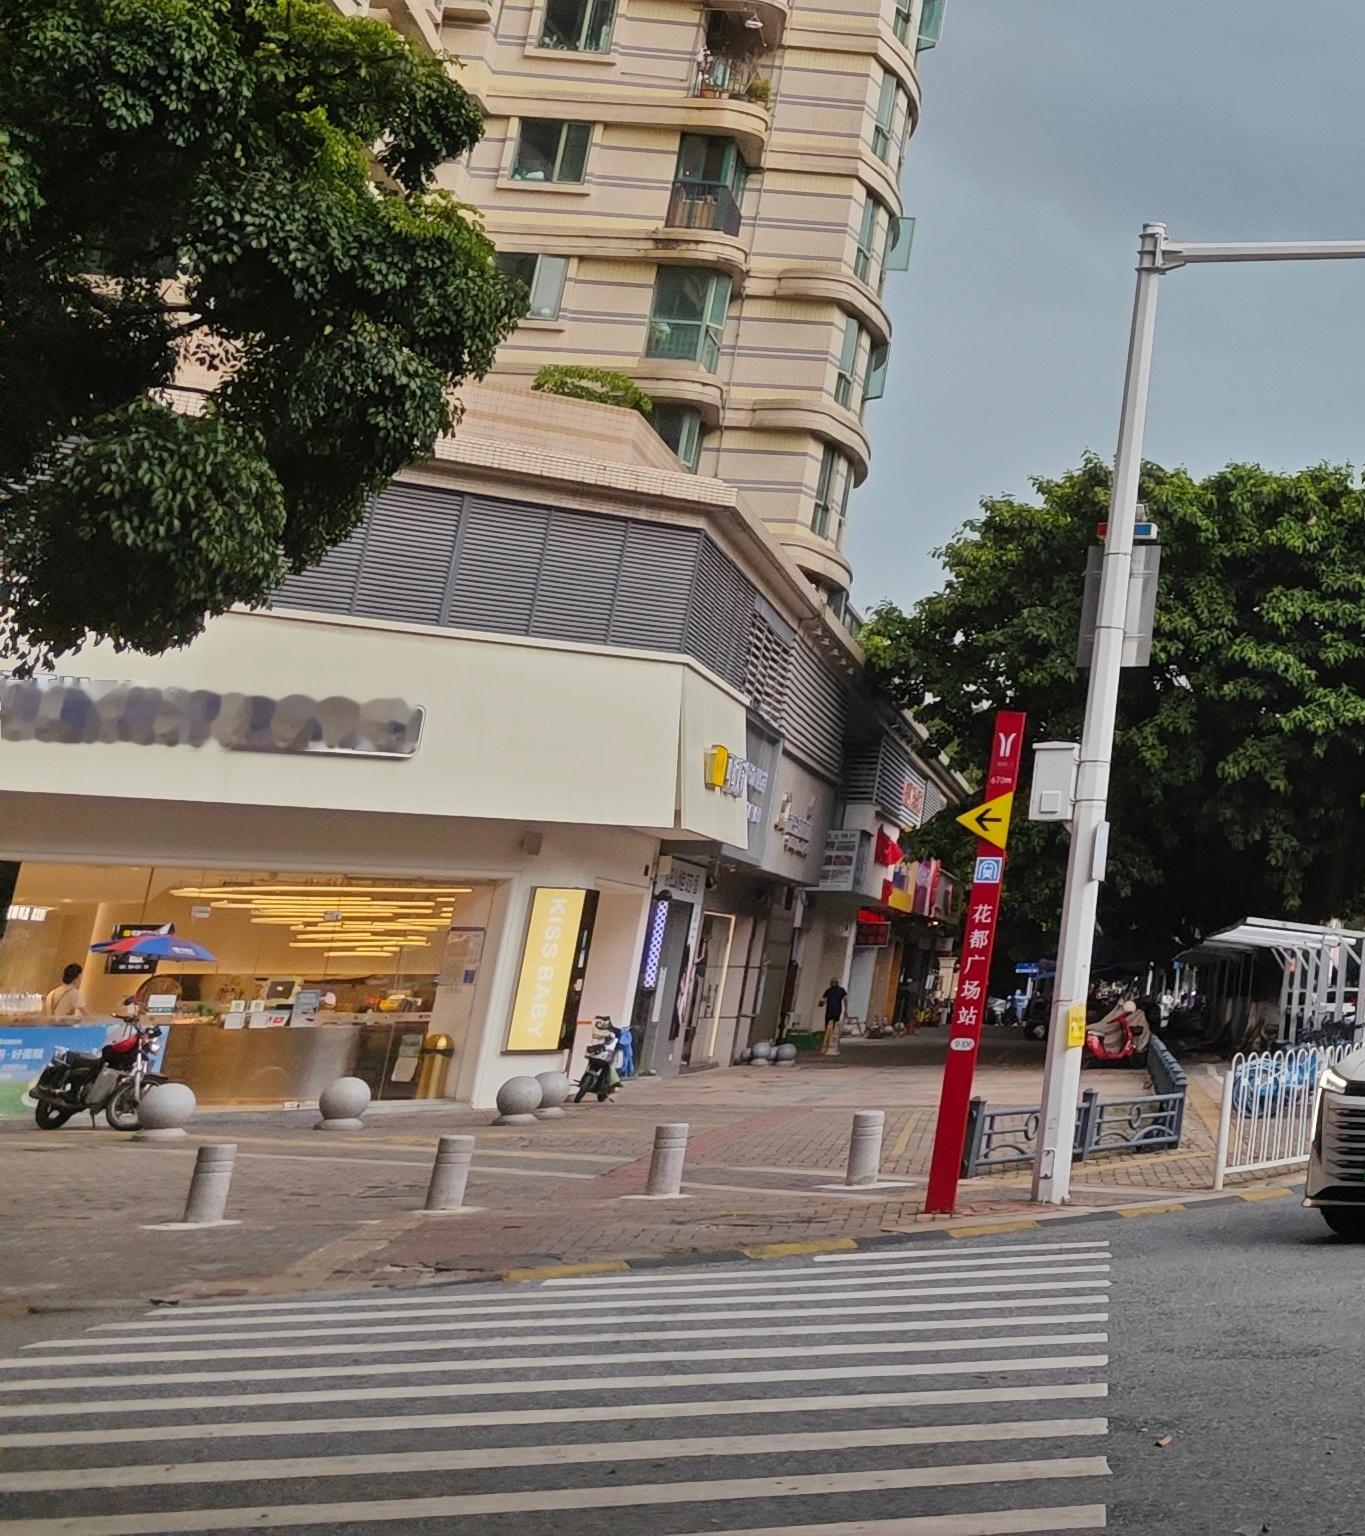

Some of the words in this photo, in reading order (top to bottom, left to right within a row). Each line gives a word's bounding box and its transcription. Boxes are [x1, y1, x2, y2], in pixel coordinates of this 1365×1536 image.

[542, 896, 567, 958] KISS
[956, 903, 994, 1026] 花都广场站
[528, 965, 554, 1039] BABY
